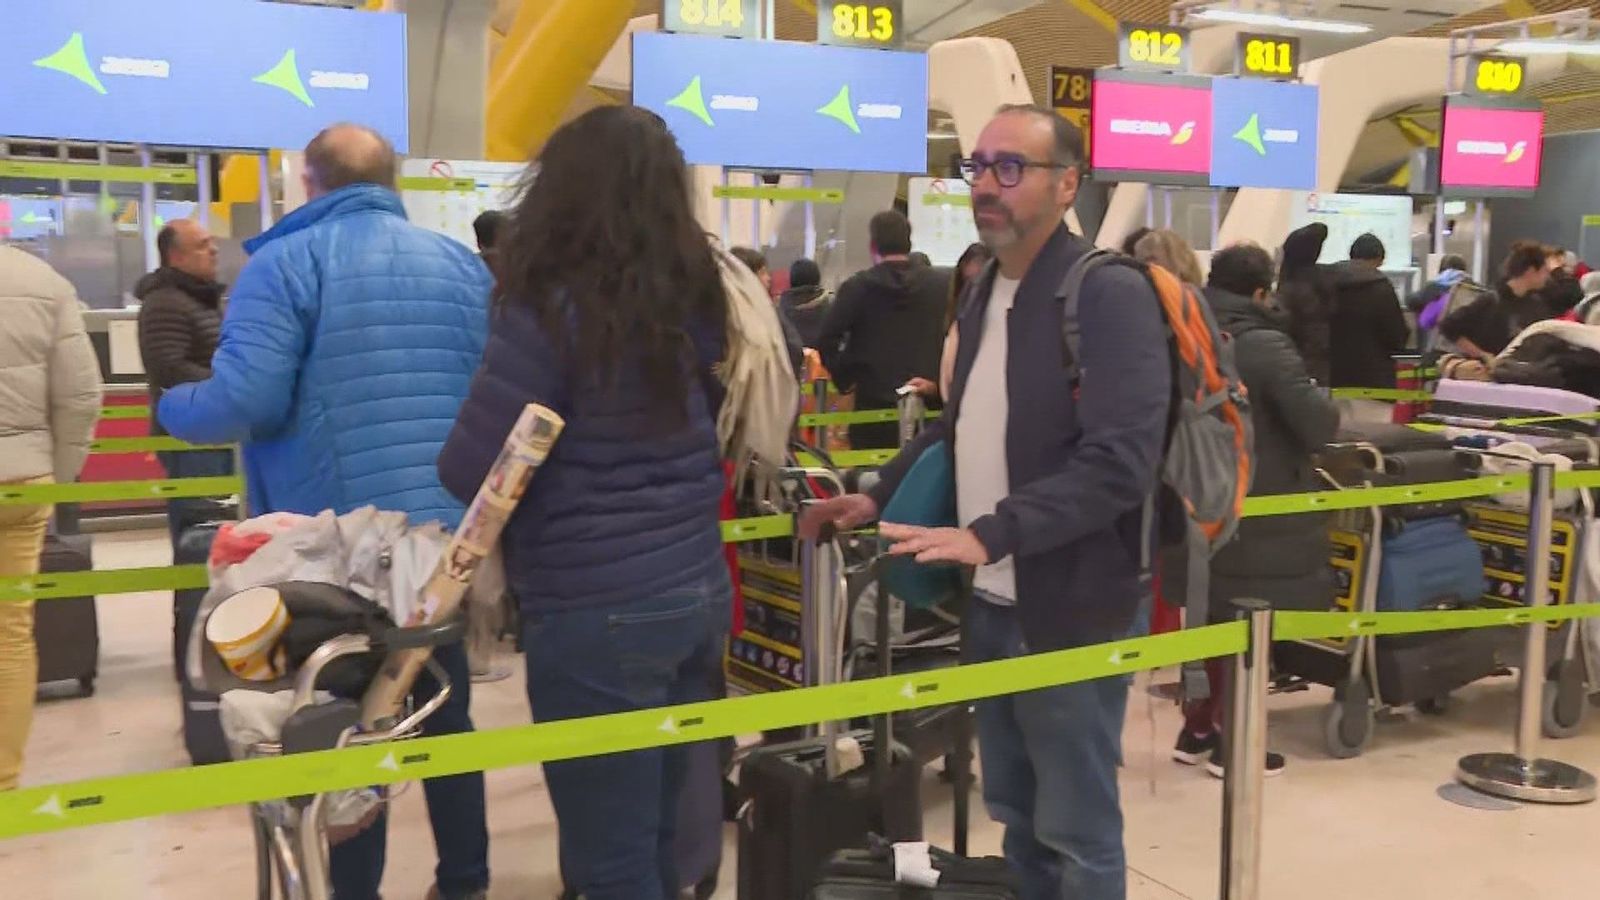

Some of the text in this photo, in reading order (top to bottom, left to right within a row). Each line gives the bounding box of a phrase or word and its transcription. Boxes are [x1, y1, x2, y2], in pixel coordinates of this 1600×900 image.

[680, 0, 744, 28] 814
[832, 4, 893, 41] 813
[1129, 29, 1182, 65] 812
[1246, 39, 1292, 73] 811
[1055, 73, 1090, 101] 78
[1476, 60, 1521, 92] 810
